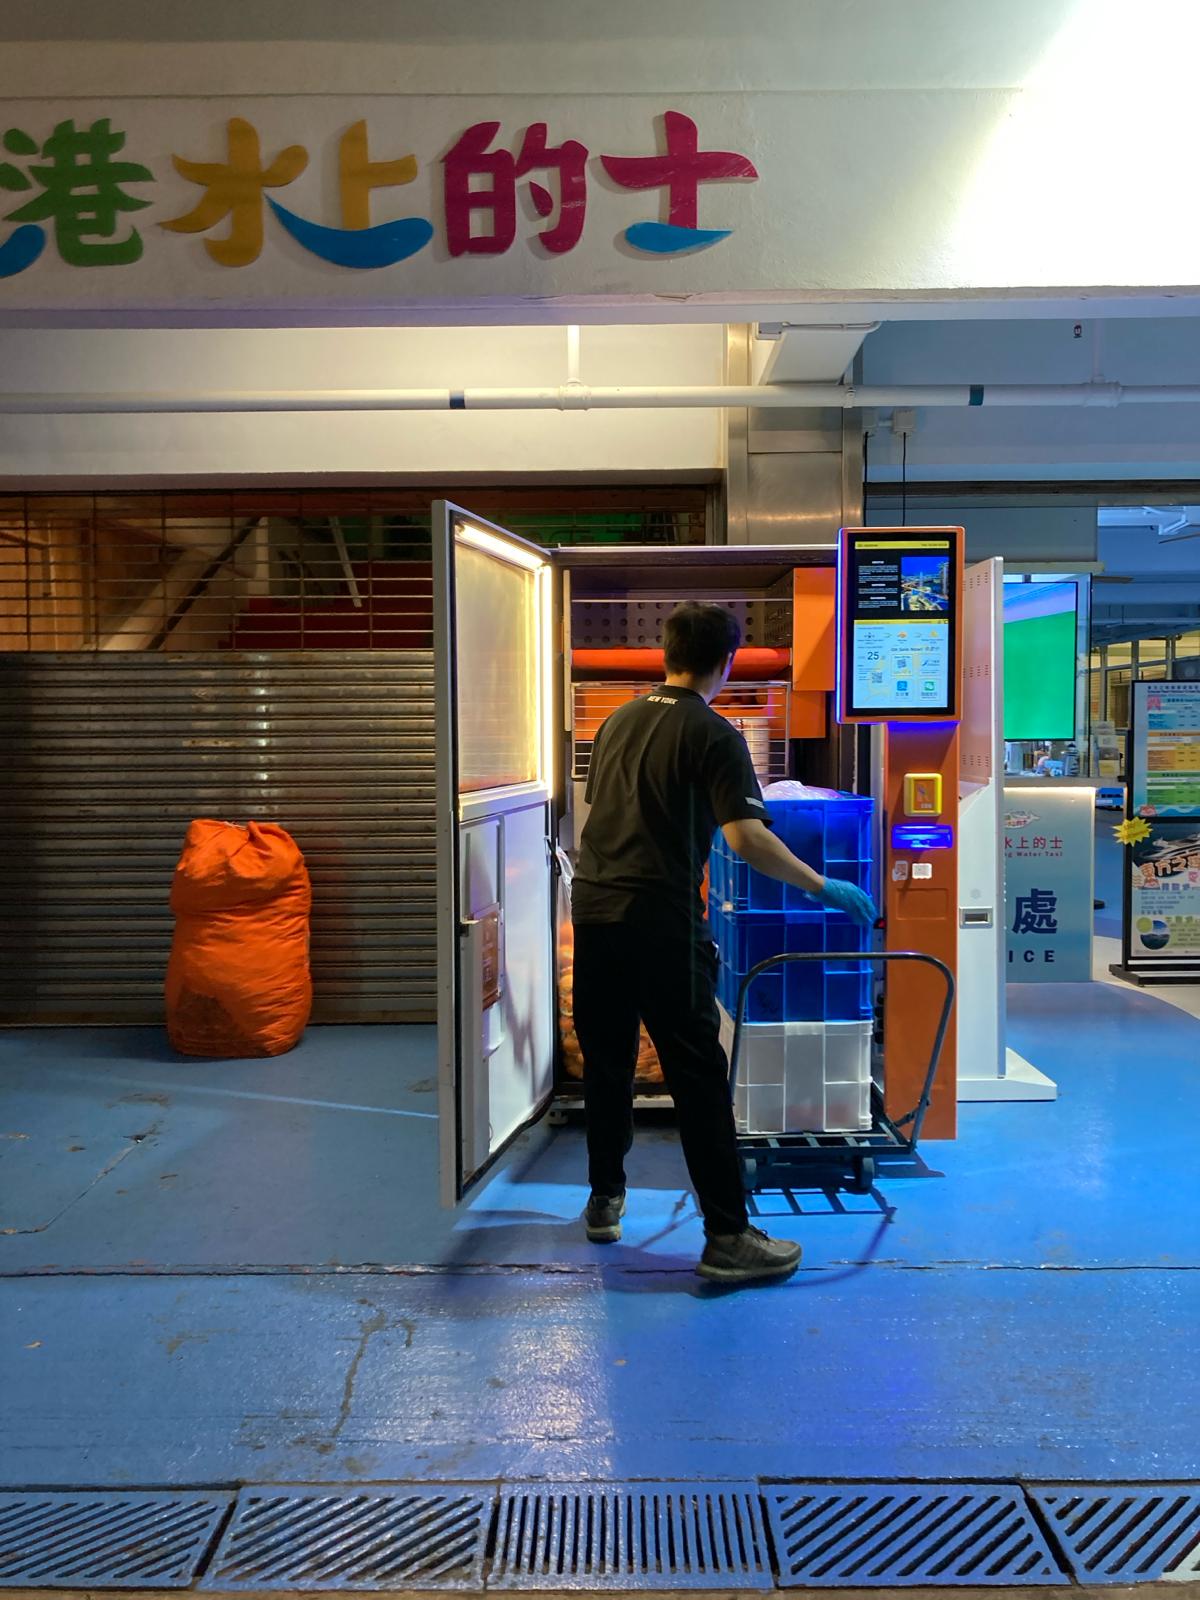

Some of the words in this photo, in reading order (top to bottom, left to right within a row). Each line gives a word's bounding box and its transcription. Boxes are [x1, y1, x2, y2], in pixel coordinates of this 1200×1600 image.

[0, 110, 758, 270] 港水上的士
[867, 651, 880, 661] 25
[1012, 888, 1058, 934] 處
